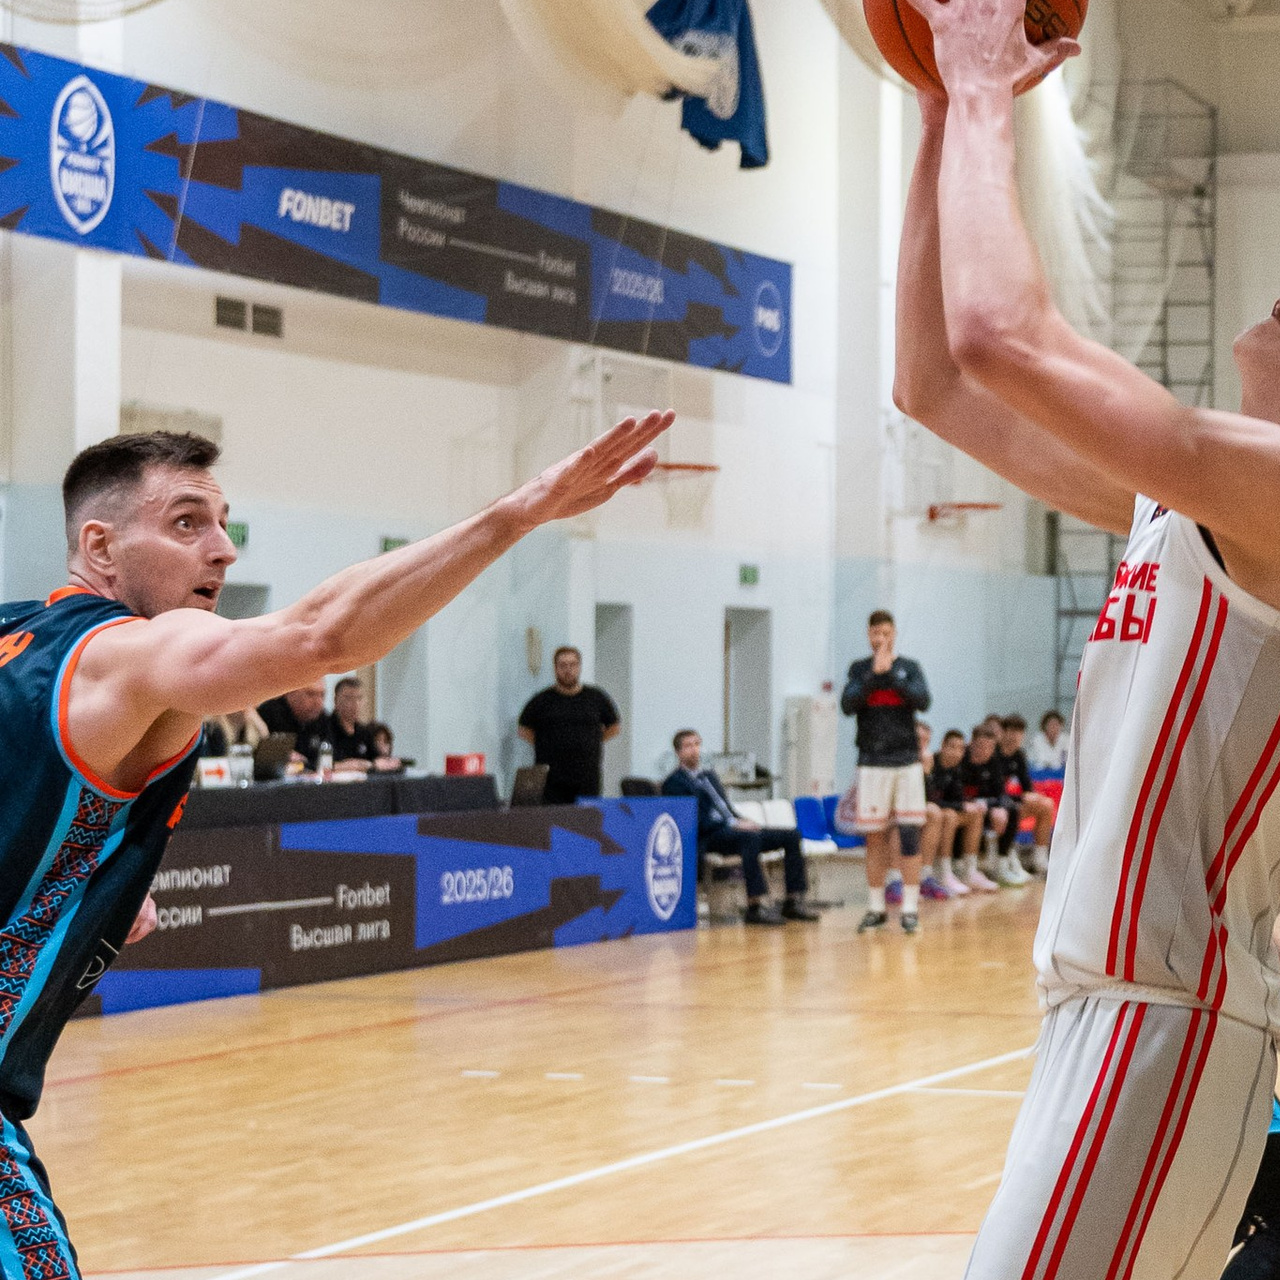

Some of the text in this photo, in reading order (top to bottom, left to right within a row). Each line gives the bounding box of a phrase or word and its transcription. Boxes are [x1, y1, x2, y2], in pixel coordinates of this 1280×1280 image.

[278, 187, 355, 232] FONBET
[1089, 593, 1157, 644] БЫ
[337, 882, 391, 909] Fonbet
[440, 866, 514, 905] 2025/26
[157, 906, 203, 931] ссии
[290, 920, 391, 952] Высшая лига
